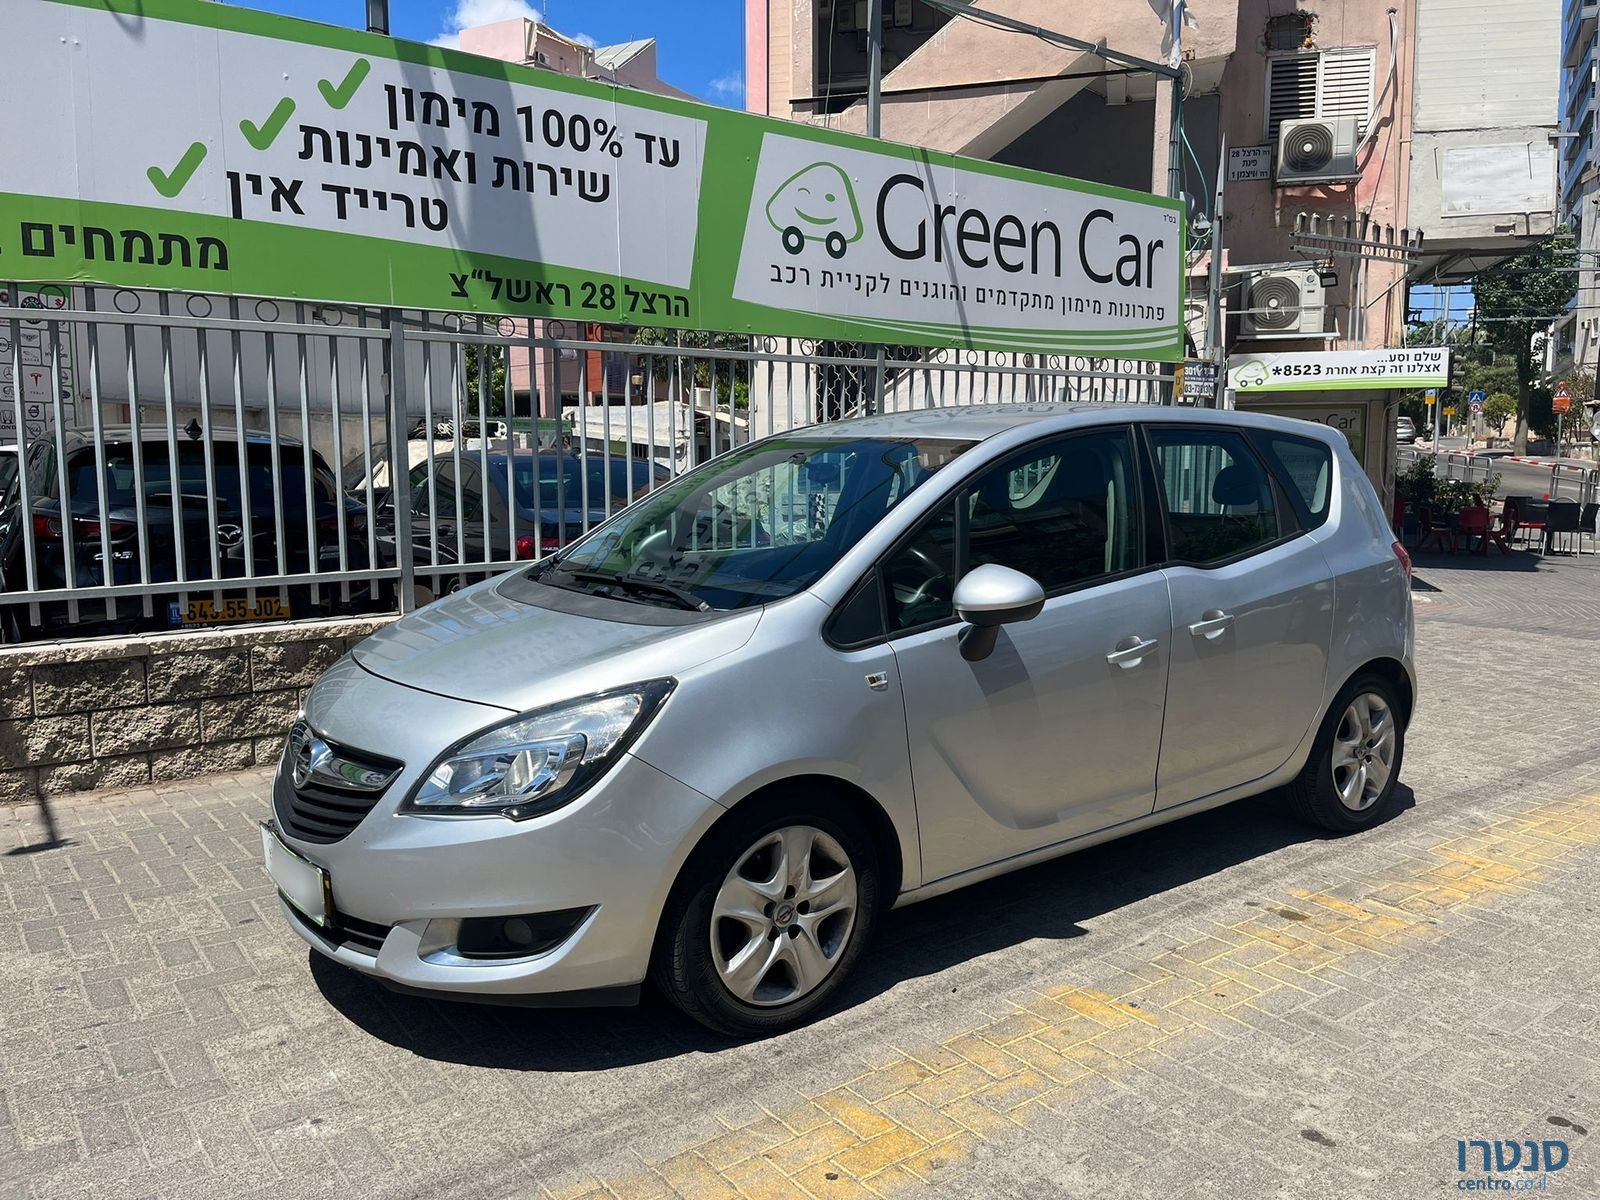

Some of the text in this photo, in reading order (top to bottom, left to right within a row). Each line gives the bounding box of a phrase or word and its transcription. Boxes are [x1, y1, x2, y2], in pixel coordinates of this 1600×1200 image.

[384, 83, 681, 169] עד 100% מימון
[297, 123, 610, 202] שירות ואמינות
[226, 170, 449, 232] טרייד אין
[20, 221, 229, 271] מתמחים
[876, 173, 1164, 289] Green Car
[449, 268, 690, 318] הרצל 28 ראשל"צ
[770, 264, 1165, 321] פתרונות מימון מתקדמים והוגנים לקניית רכב
[1324, 365, 1358, 376] אחרת
[1360, 364, 1386, 376] קצת
[1389, 363, 1404, 374] זה
[1406, 362, 1441, 373] אצלנו
[1413, 351, 1441, 362] שלם
